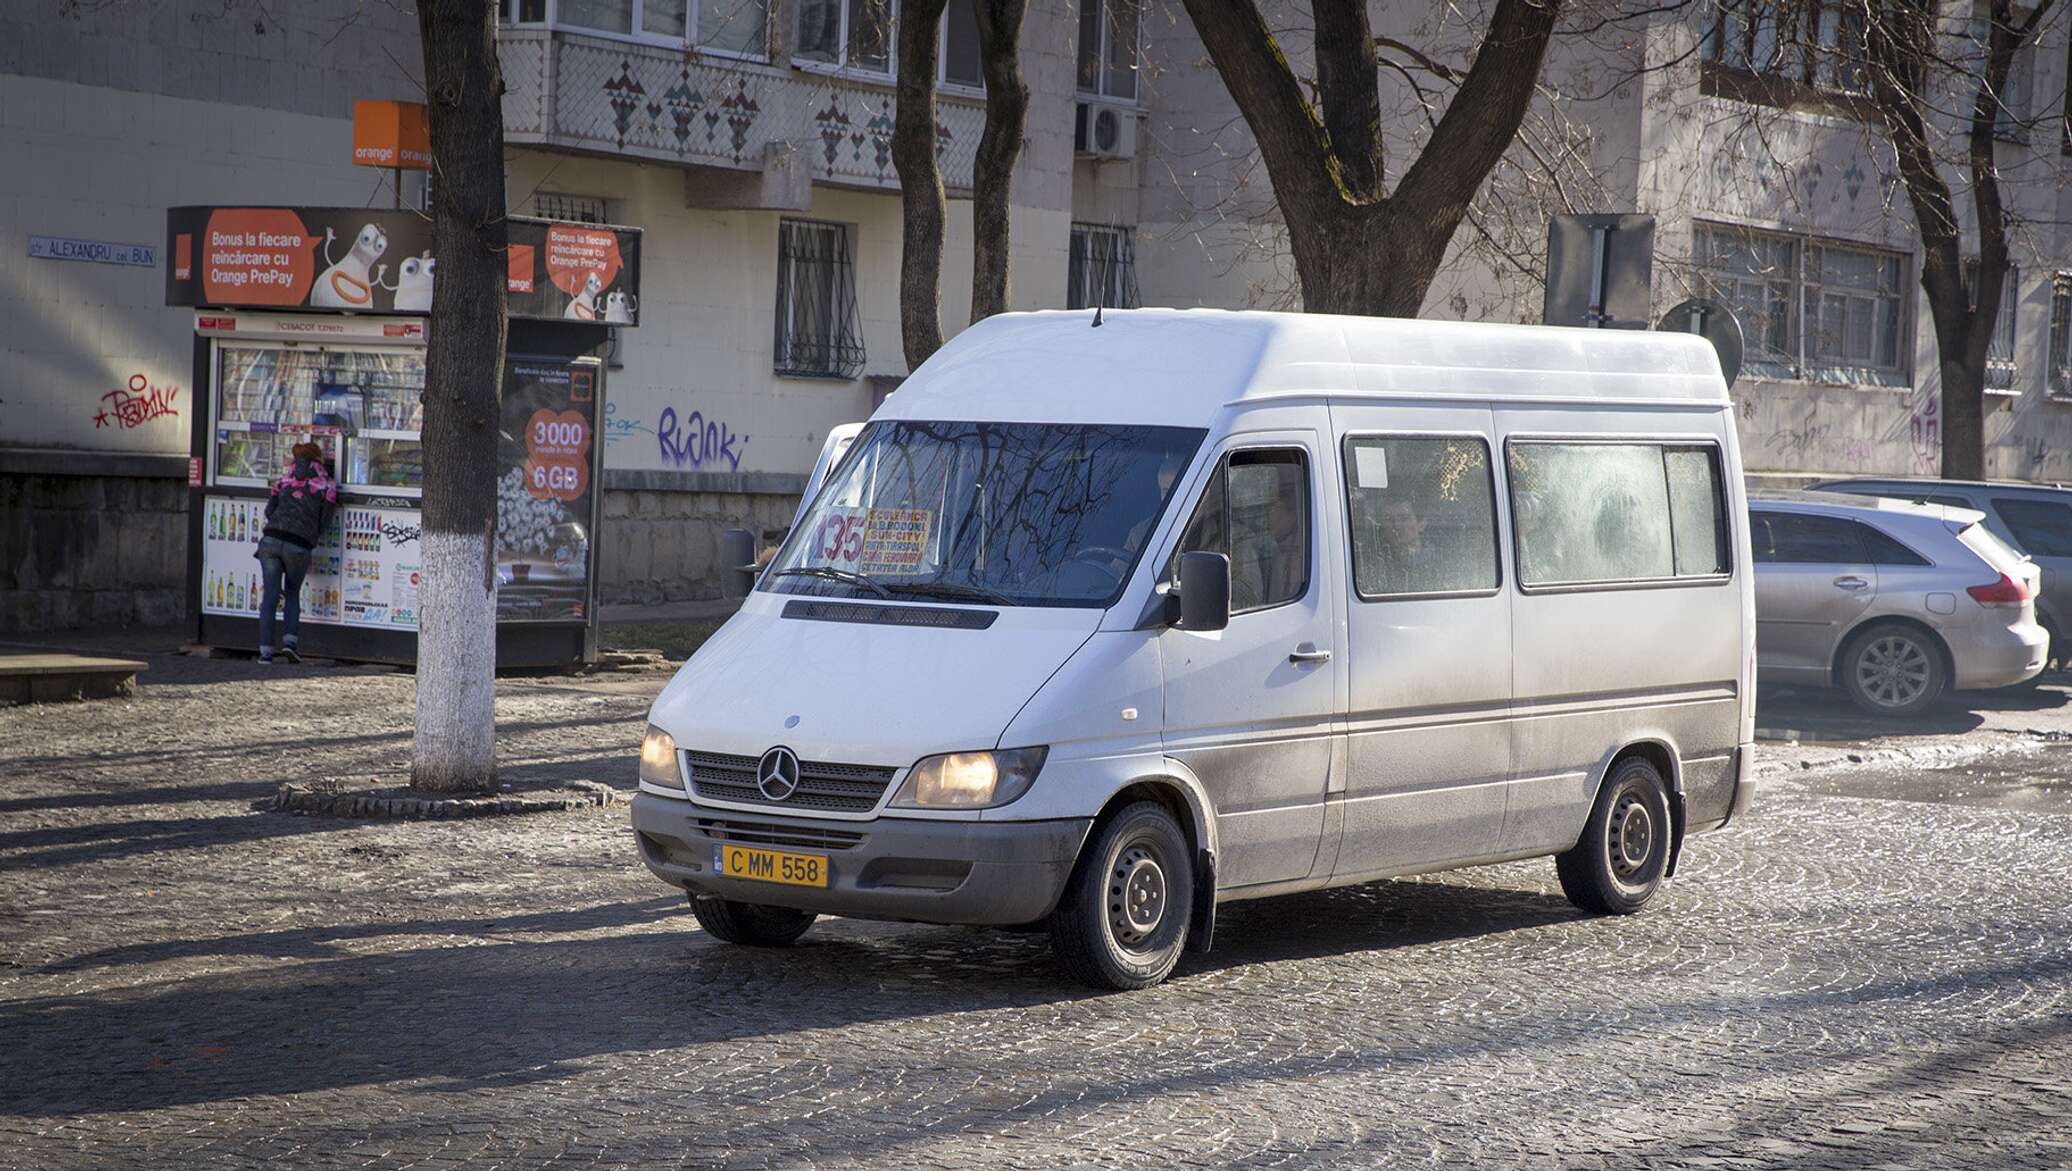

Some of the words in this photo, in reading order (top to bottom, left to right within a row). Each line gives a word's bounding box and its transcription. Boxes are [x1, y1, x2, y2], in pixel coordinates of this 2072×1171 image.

[356, 148, 393, 161] orange
[401, 150, 432, 162] orang
[212, 232, 243, 247] Bonus
[246, 232, 256, 247] la
[259, 232, 302, 247] fiecare
[551, 232, 576, 243] Bonus
[577, 234, 585, 243] la
[586, 235, 612, 247] fiecare
[49, 241, 112, 260] ALEXANDRU
[133, 248, 154, 263] BUN
[273, 254, 289, 265] cu
[595, 249, 605, 257] cu
[551, 256, 578, 268] Orange
[580, 259, 607, 271] PrePay
[211, 268, 248, 286] Orange
[250, 269, 293, 287] PrePay
[534, 421, 582, 446] 3000
[534, 465, 546, 489] 6
[549, 465, 578, 490] GB
[816, 514, 864, 561] 135
[731, 850, 743, 873] C
[748, 852, 774, 877] MM
[781, 855, 818, 882] 558
